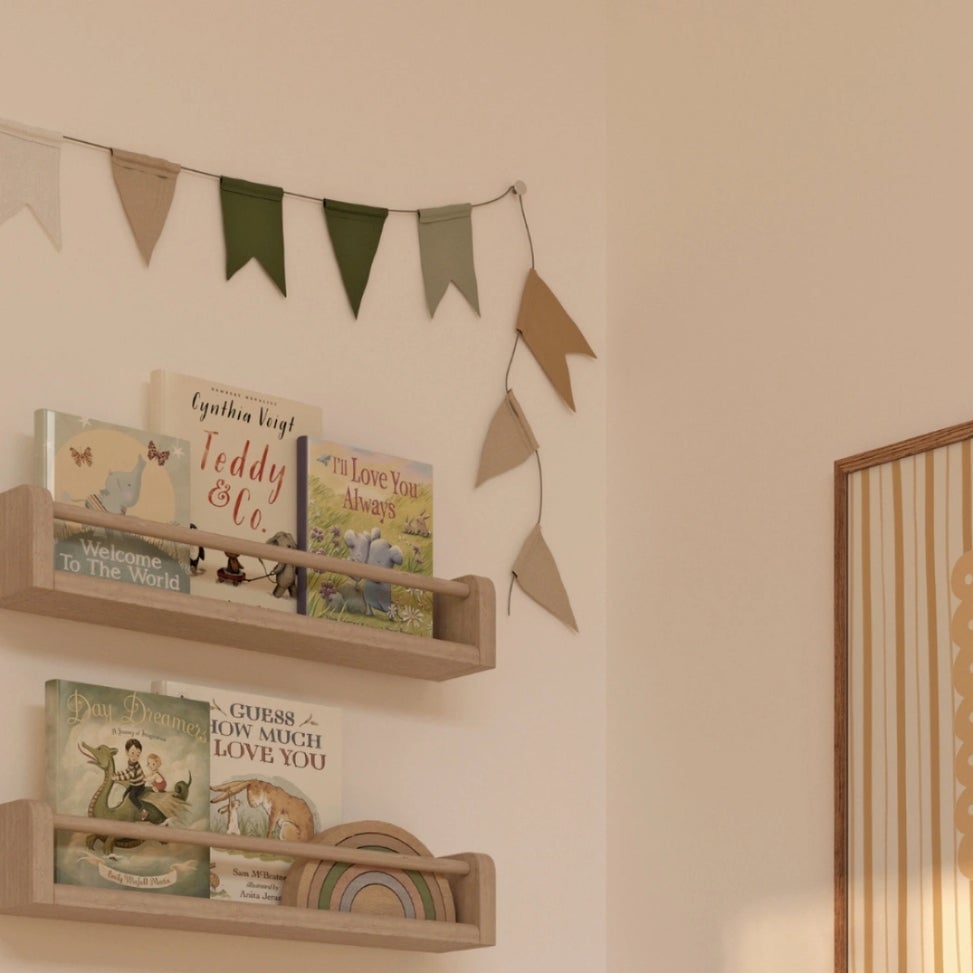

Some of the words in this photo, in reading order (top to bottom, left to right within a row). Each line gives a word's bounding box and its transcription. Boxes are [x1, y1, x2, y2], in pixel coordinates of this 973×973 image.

[192, 391, 251, 422] Cynthia
[259, 406, 295, 440] Voigt
[200, 429, 286, 505] Teddy
[332, 456, 348, 476] I'll
[351, 457, 388, 489] Love
[390, 470, 418, 498] You
[342, 486, 396, 524] Always
[59, 552, 81, 573] To
[86, 557, 121, 579] The
[127, 565, 180, 591] World
[80, 538, 162, 569] Welcome
[67, 689, 112, 726] Day
[120, 691, 208, 743] Dreamers
[229, 702, 296, 727] GUESS
[214, 738, 275, 764] LOVE
[279, 747, 327, 771] YOU
[259, 726, 322, 749] MUCH
